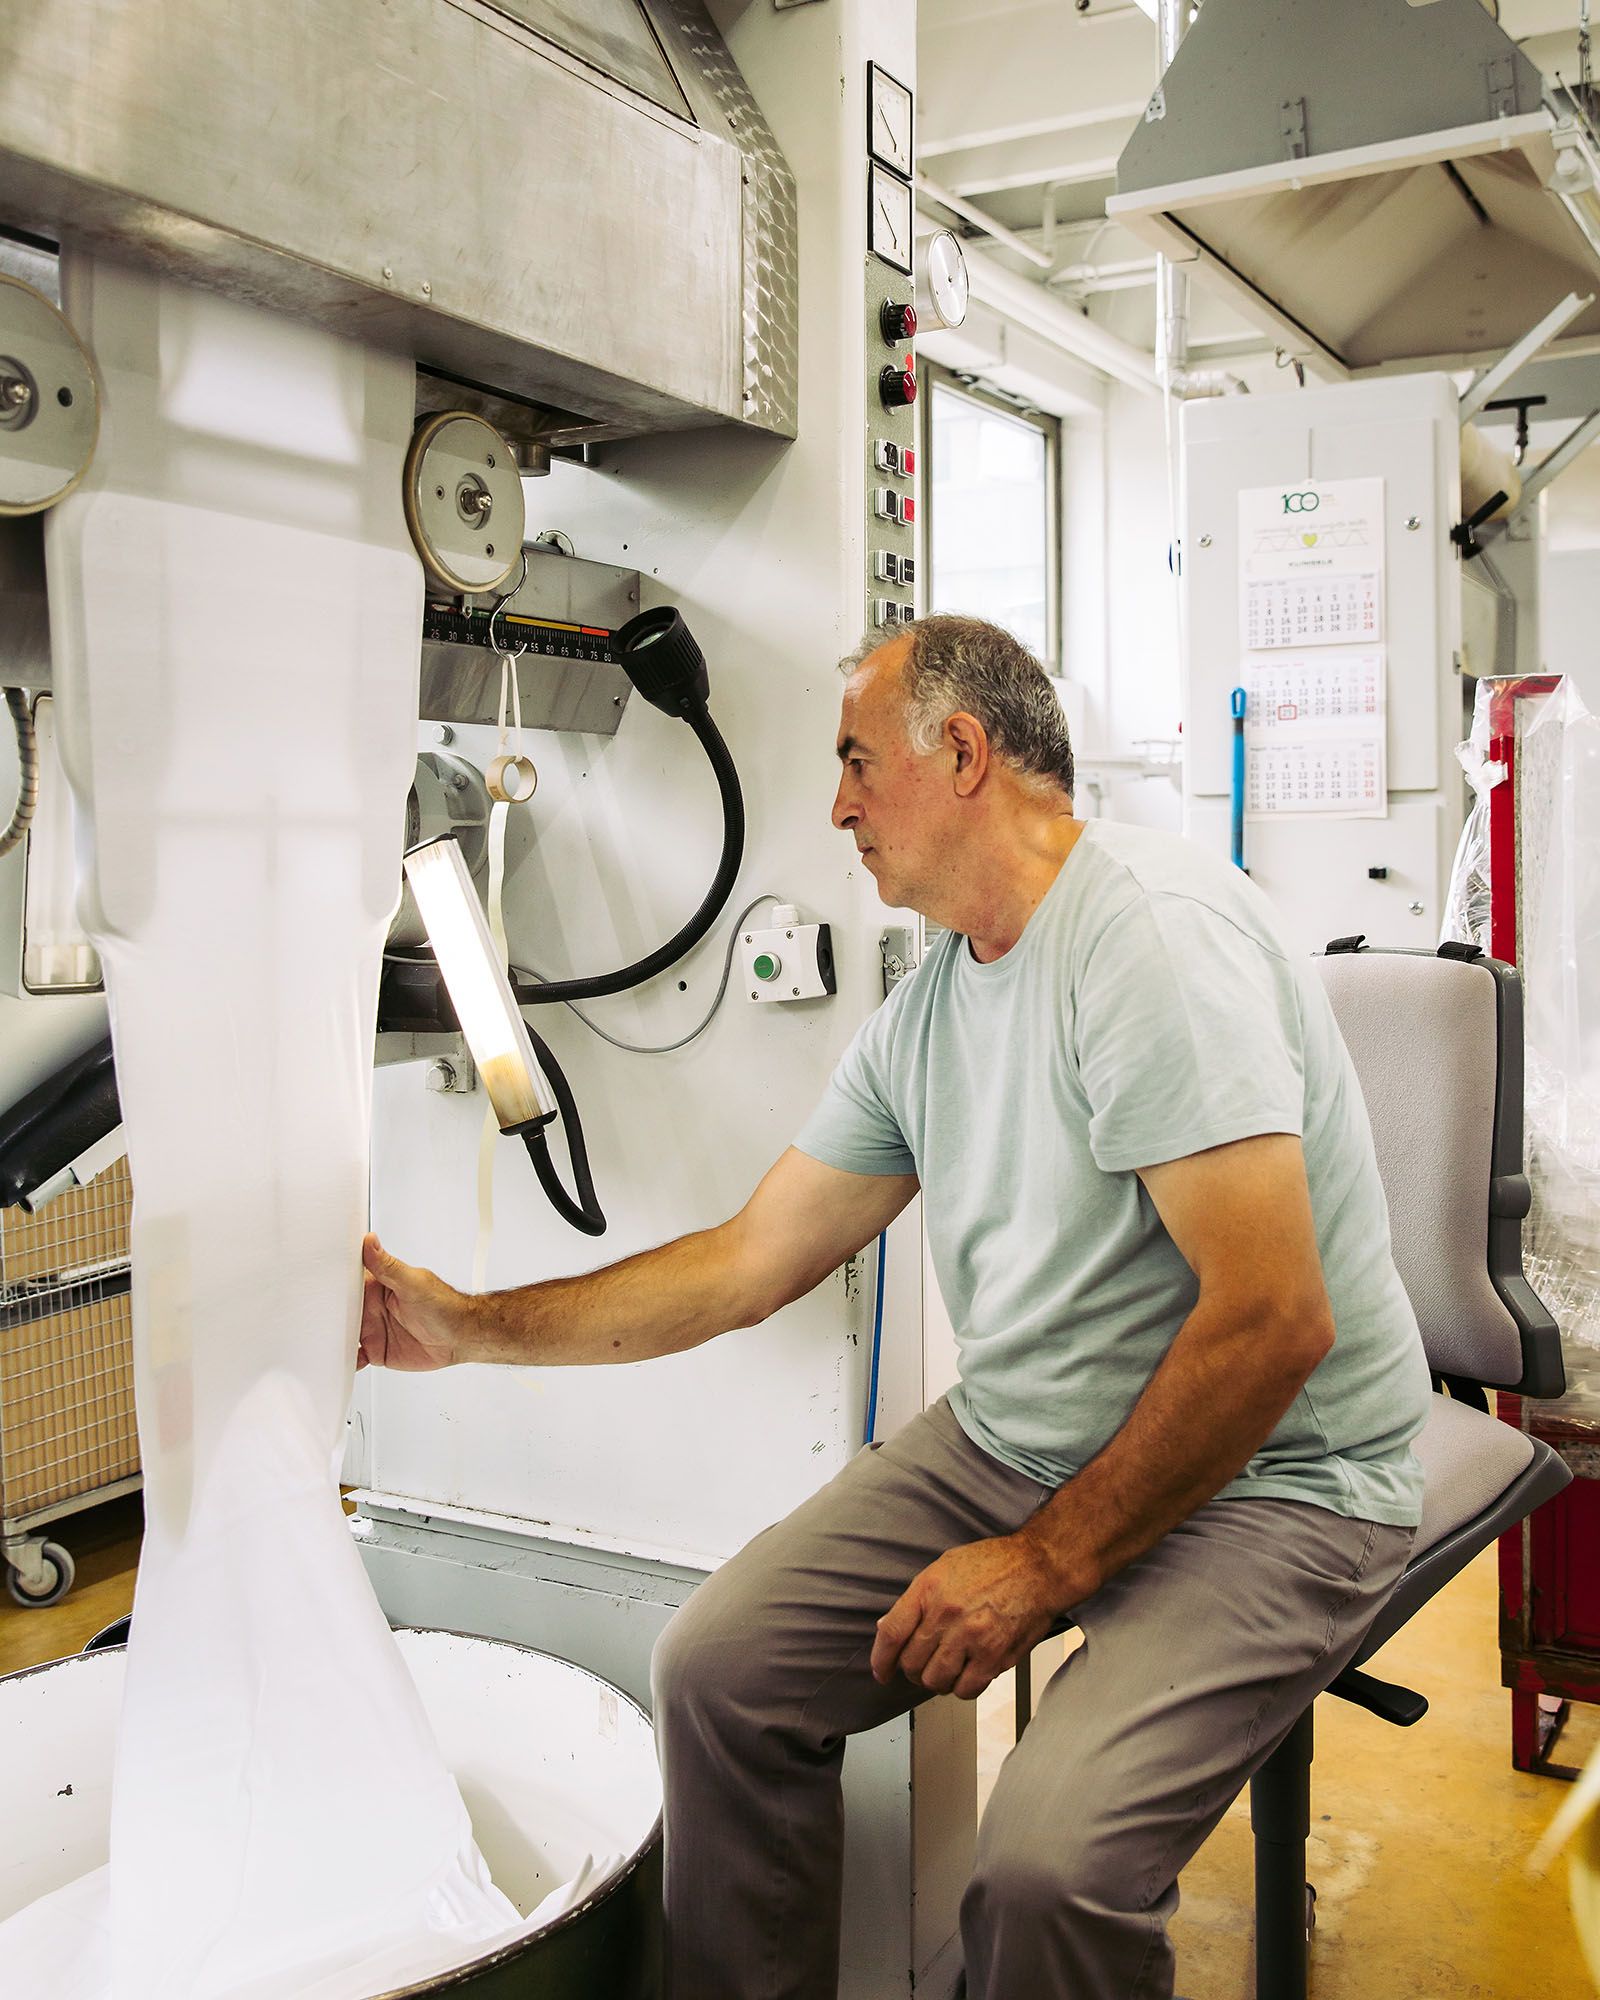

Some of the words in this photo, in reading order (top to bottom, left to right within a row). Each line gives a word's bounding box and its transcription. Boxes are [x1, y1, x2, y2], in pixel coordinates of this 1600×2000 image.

[1281, 491, 1319, 514] 100
[430, 628, 440, 640] 25
[448, 631, 458, 641] 30
[465, 633, 475, 644] 35
[498, 638, 508, 648] 45
[530, 642, 539, 653] 55
[545, 644, 555, 655] 60
[560, 646, 569, 657] 65
[575, 648, 584, 658] 70
[590, 650, 599, 660] 75
[603, 652, 612, 662] 80
